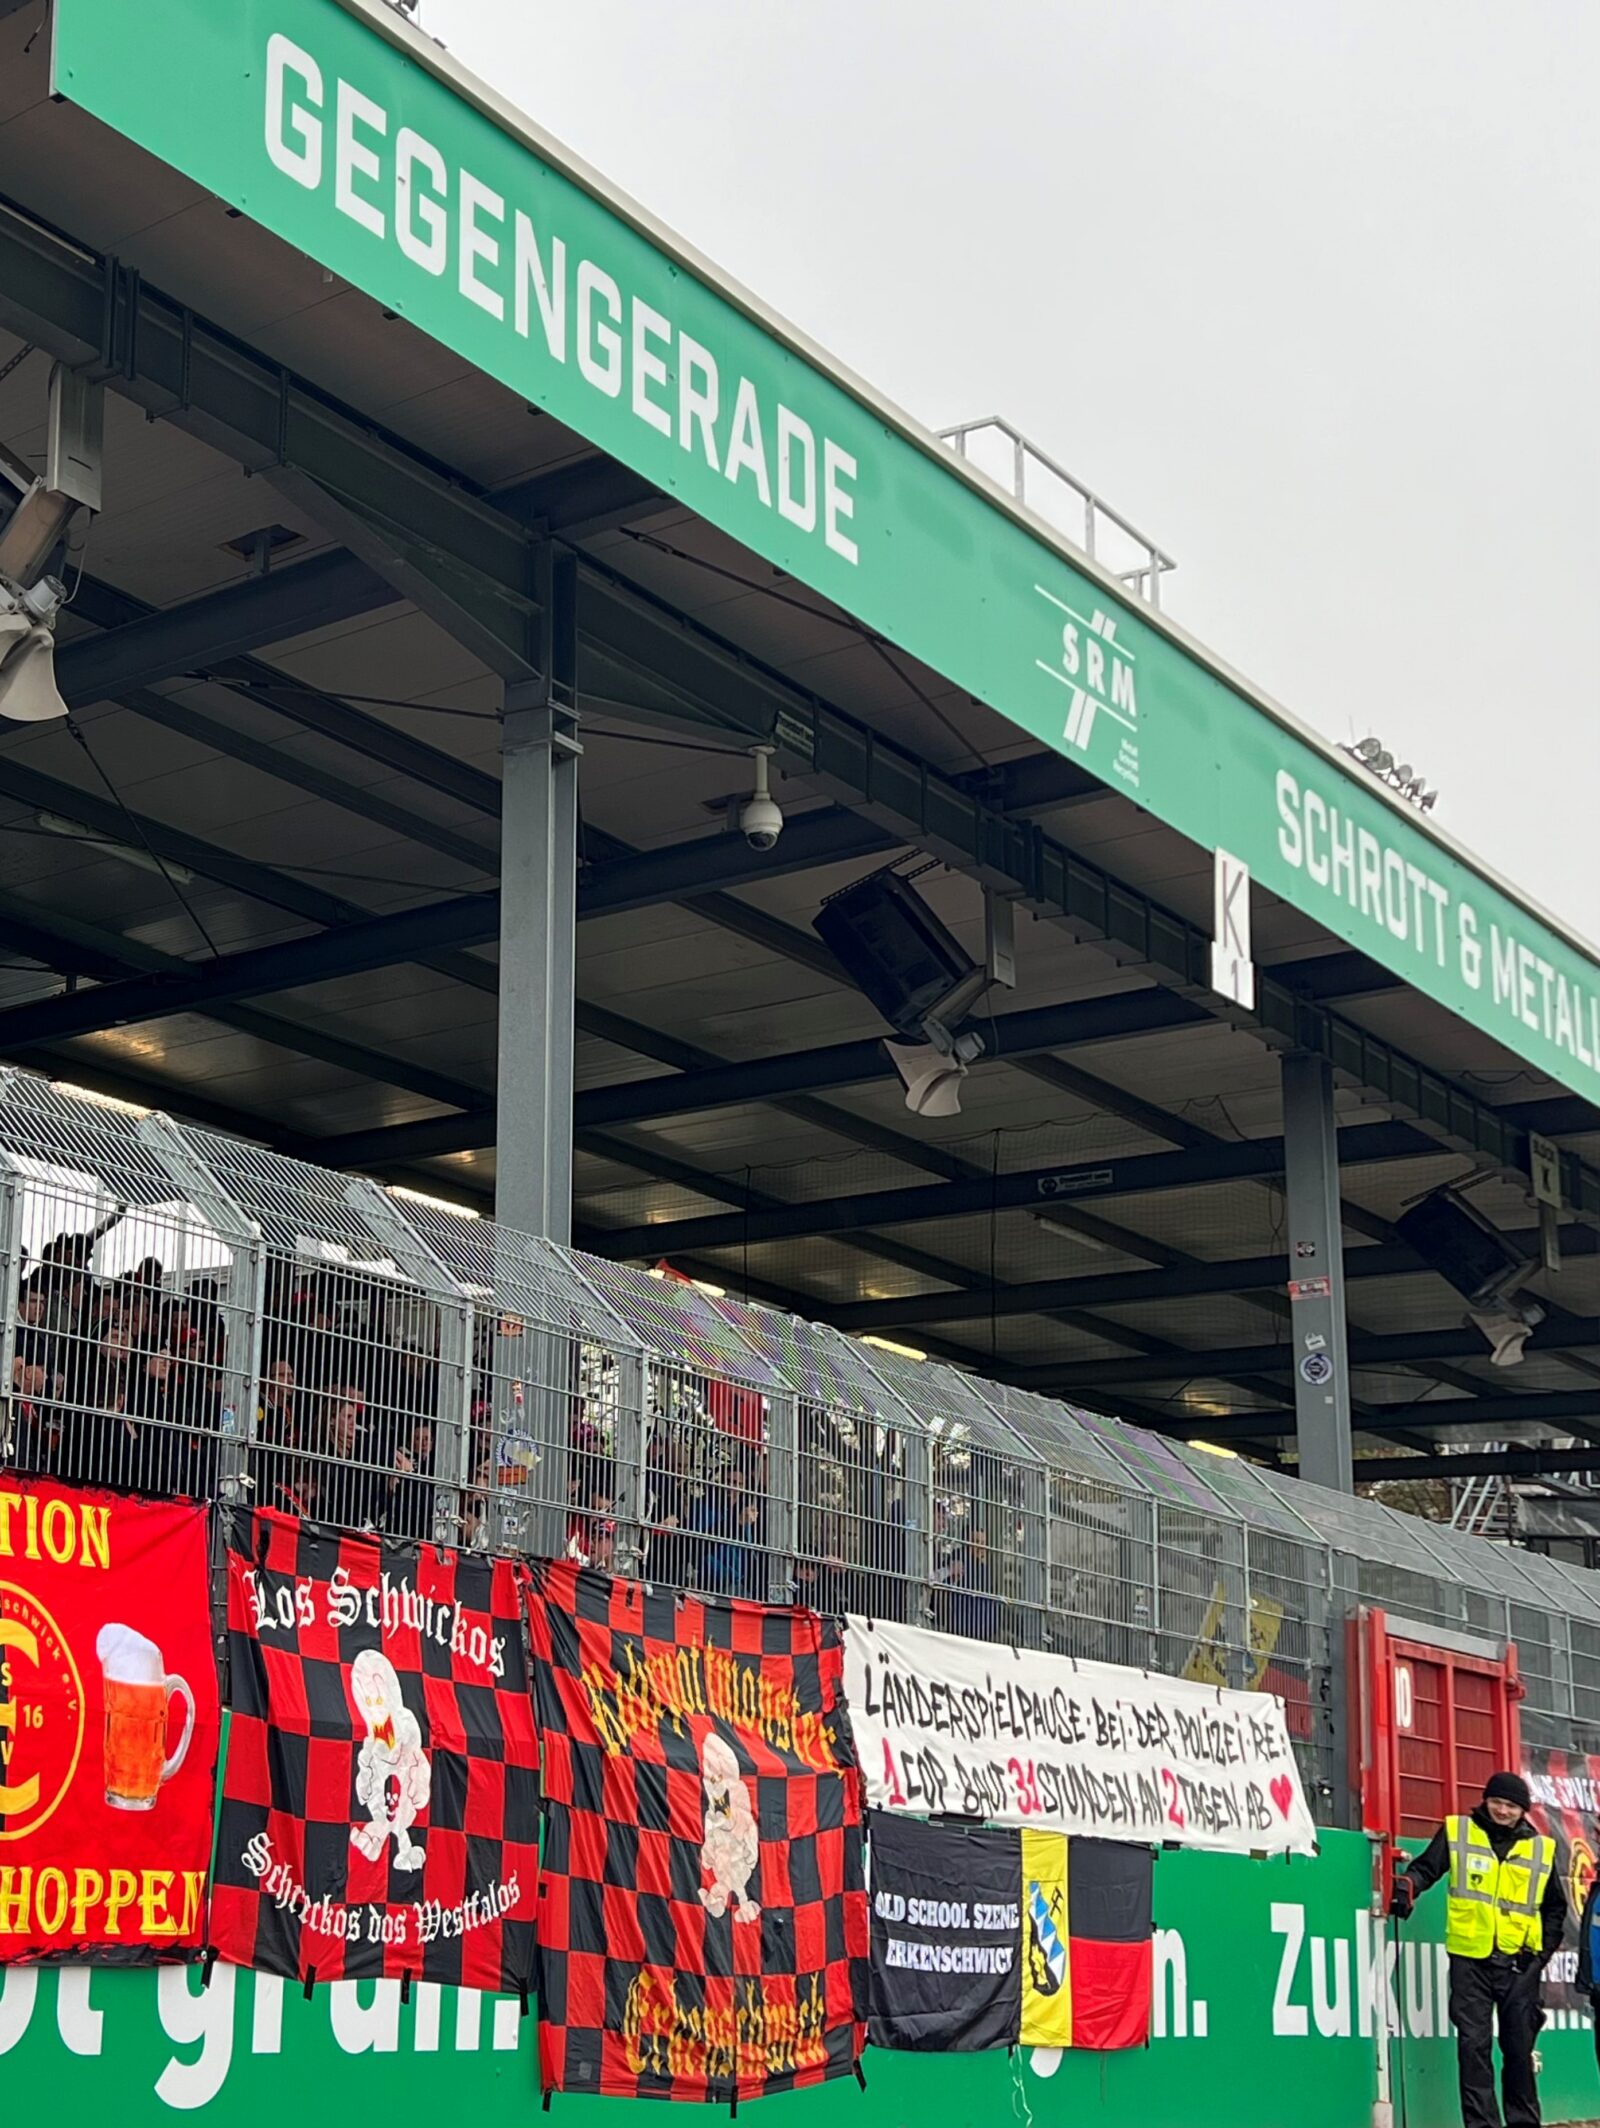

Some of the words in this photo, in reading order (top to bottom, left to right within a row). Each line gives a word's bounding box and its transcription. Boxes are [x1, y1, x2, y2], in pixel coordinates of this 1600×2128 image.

[265, 33, 859, 566] GEGENGERADE
[1062, 622, 1137, 718] SRM
[1222, 860, 1244, 959] K
[1276, 769, 1449, 968] SCHROTT
[1458, 901, 1482, 990] &
[242, 1569, 316, 1631] Los
[327, 1566, 507, 1678] Schwickos
[23, 1704, 44, 1729] 16
[1132, 1701, 1177, 1760] DER
[882, 1737, 906, 1806] 1
[953, 1753, 1008, 1820] BAUT
[1008, 1757, 1042, 1815] 31
[1036, 1761, 1137, 1827] STUNDEN
[1136, 1766, 1164, 1826] AN
[1160, 1767, 1185, 1830] 2
[1176, 1773, 1241, 1835] TAGEN
[1245, 1780, 1273, 1831] AB
[241, 1831, 361, 1942] Schreckos
[366, 1903, 407, 1944] dos
[412, 1869, 521, 1944] Westfalos
[874, 1890, 906, 1922] OLD
[907, 1897, 971, 1929] SCHOOL
[973, 1902, 1020, 1931] SZENE
